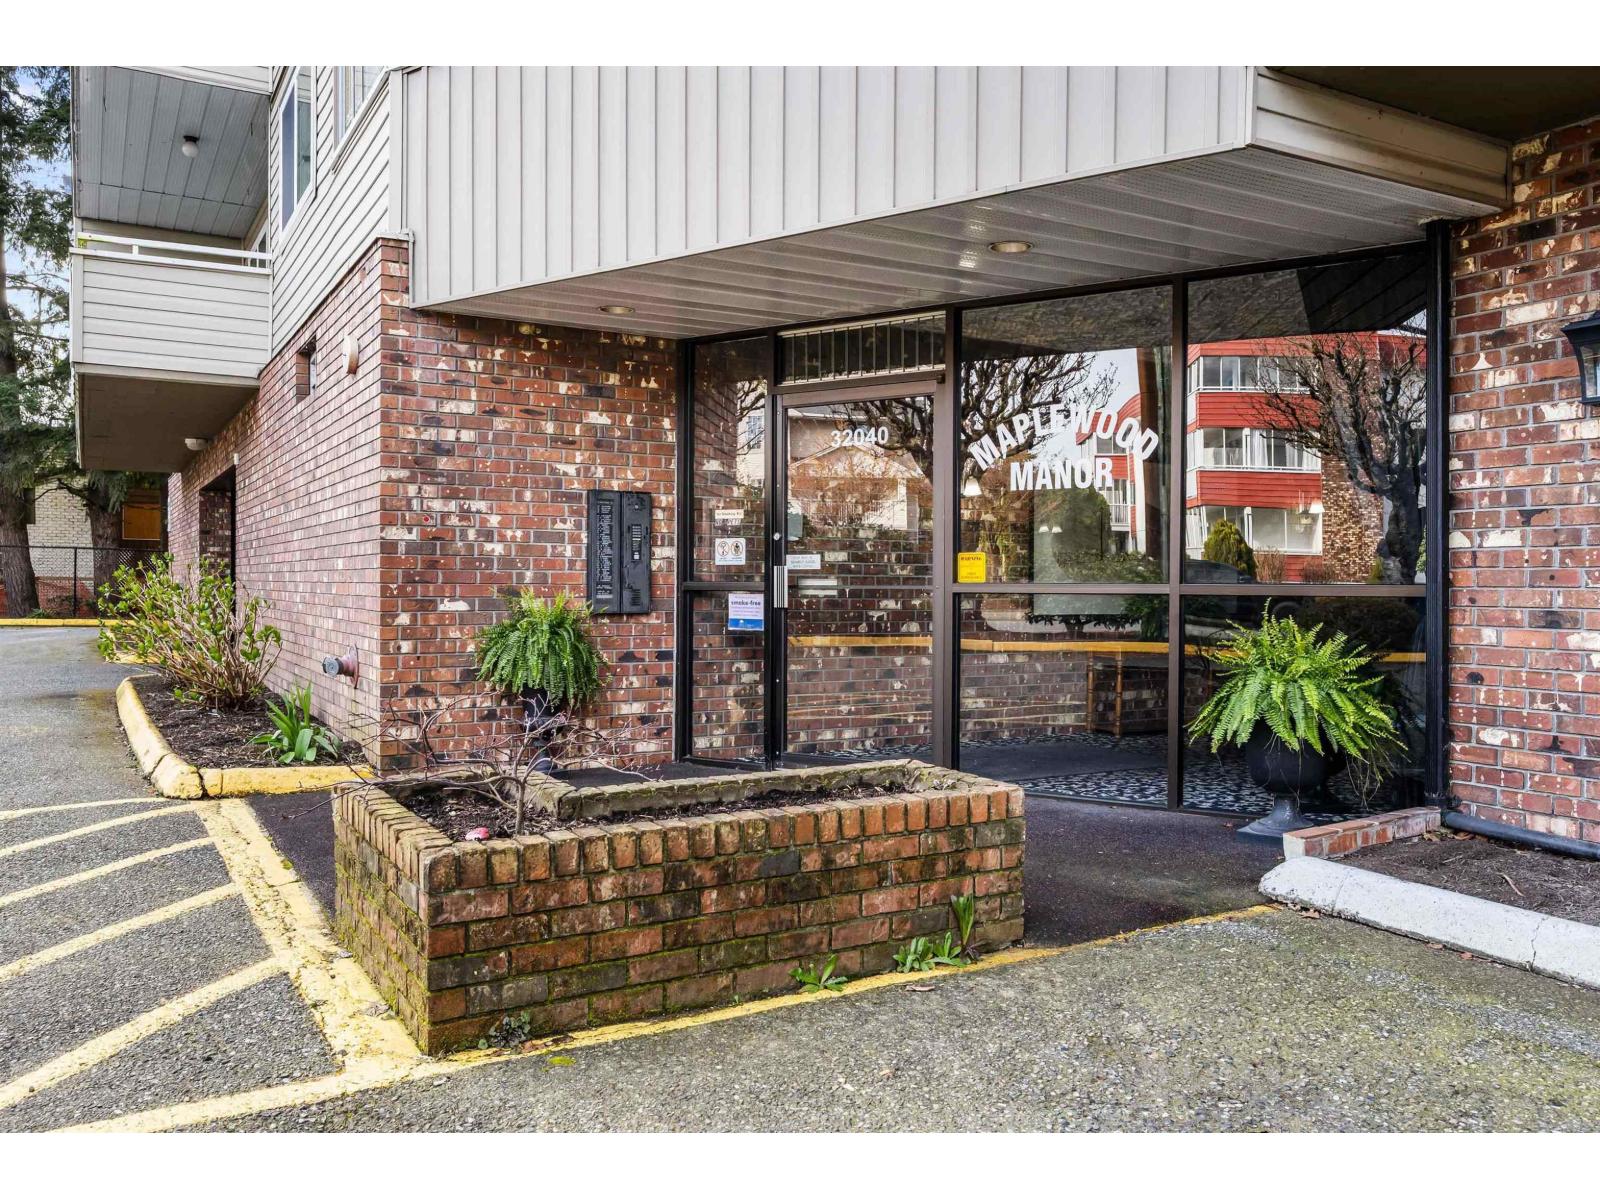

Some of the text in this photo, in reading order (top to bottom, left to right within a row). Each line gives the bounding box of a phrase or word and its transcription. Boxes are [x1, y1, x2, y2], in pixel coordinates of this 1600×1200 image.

[830, 426, 889, 447] 32040
[967, 402, 1159, 471] MAPLEWOOD
[1010, 457, 1113, 492] MANOR
